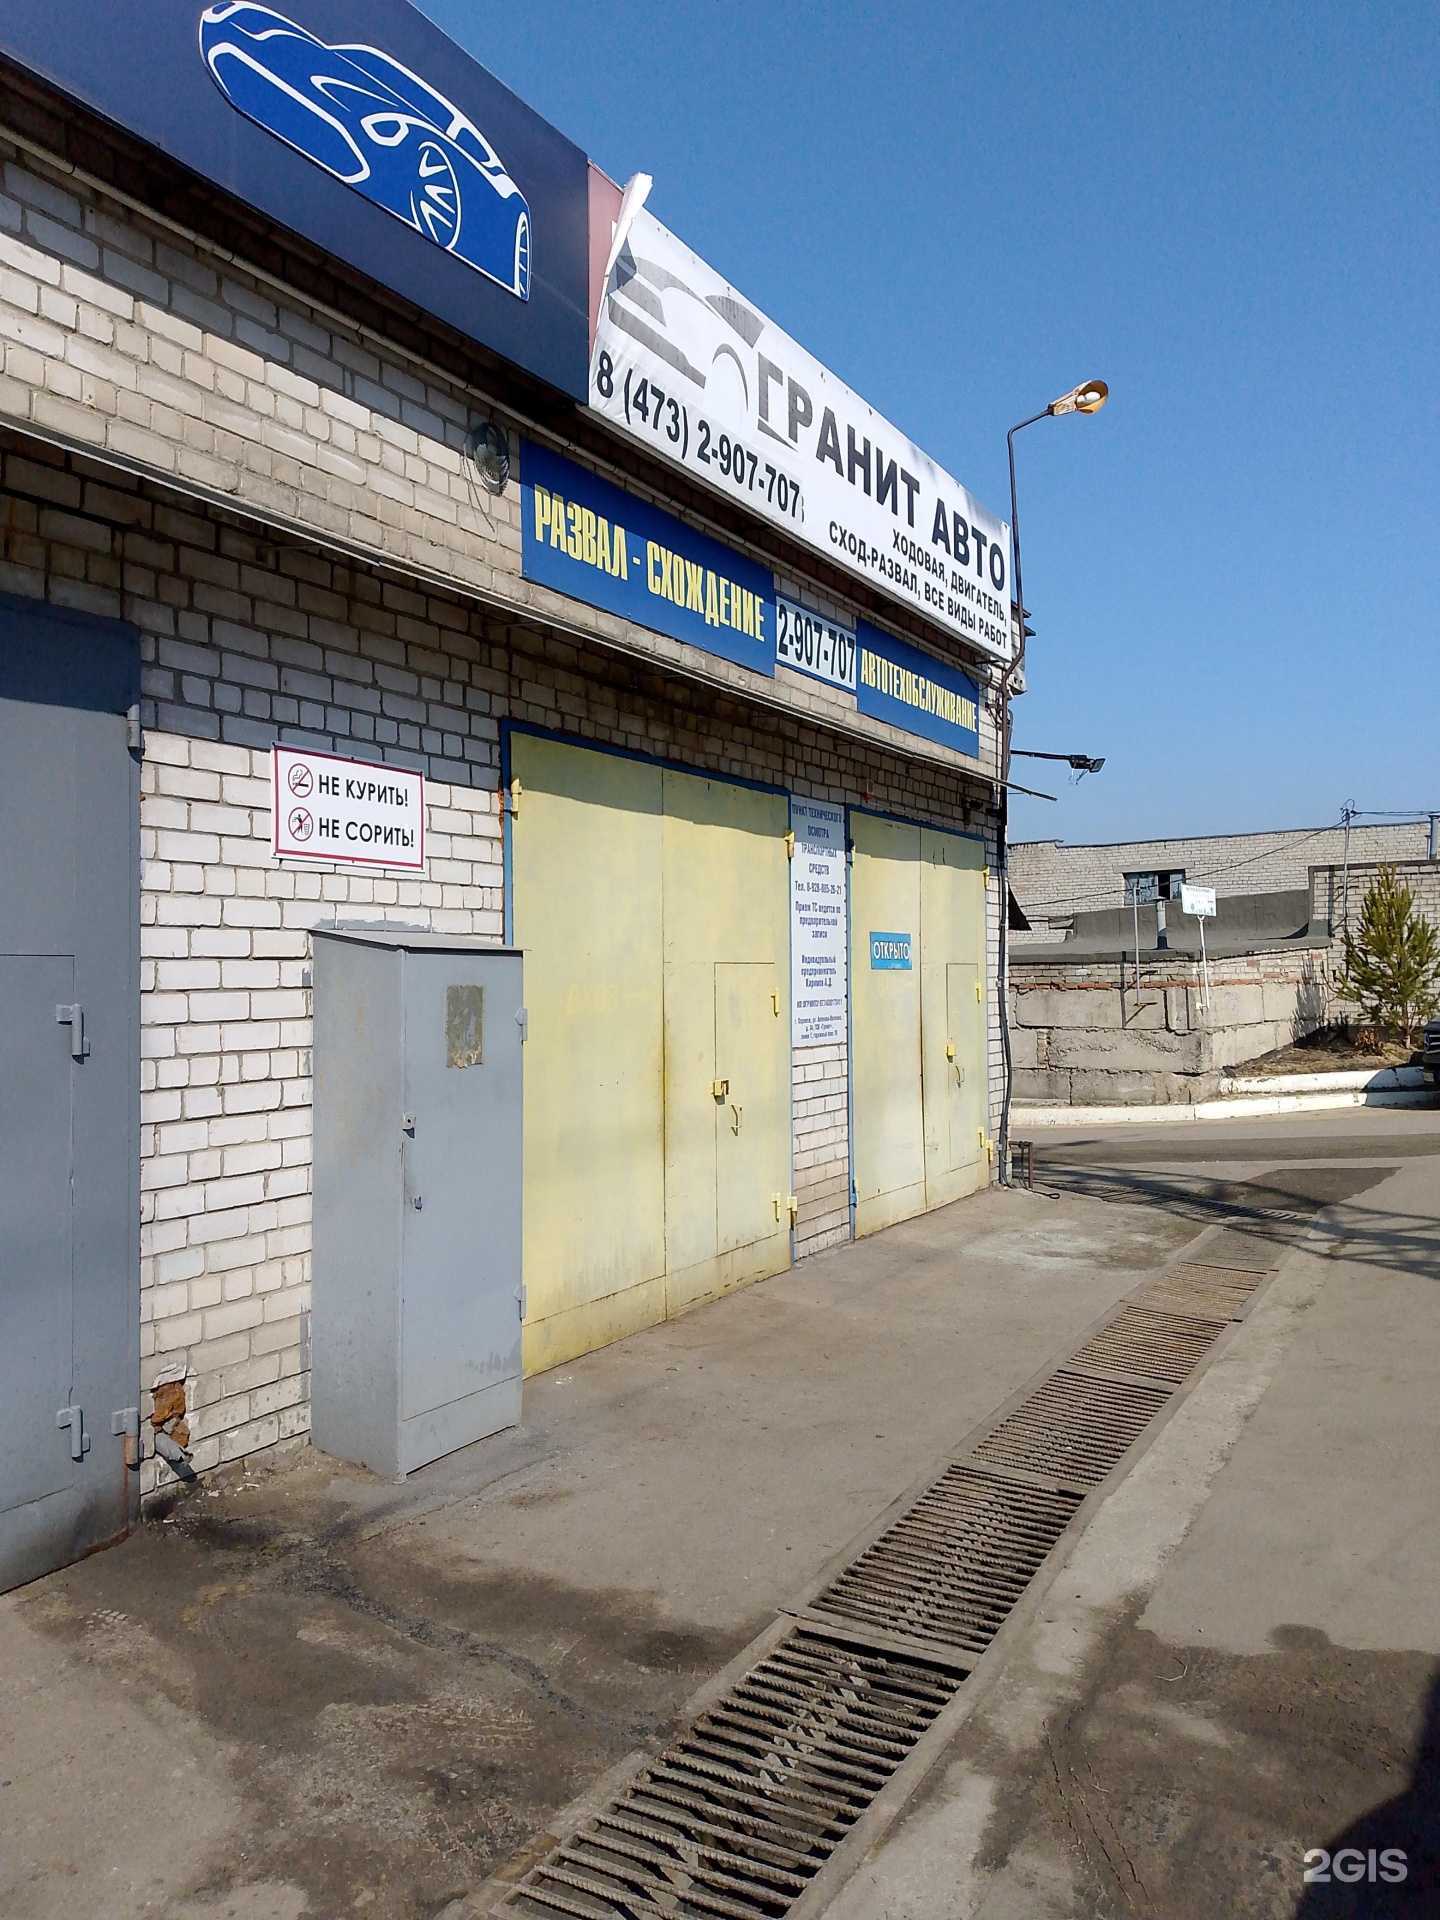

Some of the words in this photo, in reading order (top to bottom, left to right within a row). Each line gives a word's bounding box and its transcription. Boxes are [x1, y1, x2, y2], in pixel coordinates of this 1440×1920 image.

[596, 350, 615, 398] 8
[624, 368, 689, 459] (473)
[696, 419, 800, 521] 2-907-707
[758, 351, 921, 528] ГРАНИТ
[931, 497, 1006, 592] АВТО
[534, 483, 628, 581] РАЗВАЛ
[646, 540, 765, 643] СХОЖДЕНИЕ
[828, 520, 922, 601] СХОД-РАЗВАЛ,
[924, 584, 945, 617] ВСЕ
[946, 597, 977, 633] ВИДЫ
[978, 613, 1008, 650] РАБОТ
[892, 528, 948, 588] ХОДОВАЯ,
[949, 567, 1008, 625] ДВИГАТЕЛЬ,
[777, 603, 855, 684] 2-907-707
[860, 647, 978, 733] АВТОТЕХОБСЛУЖИВАНИЕ
[318, 774, 340, 796] НЕ
[345, 779, 409, 807] КУРИТЬ!
[318, 817, 341, 839] НЕ
[345, 821, 414, 848] СОРИТЬ!
[873, 941, 909, 960] ОТКРЫТО
